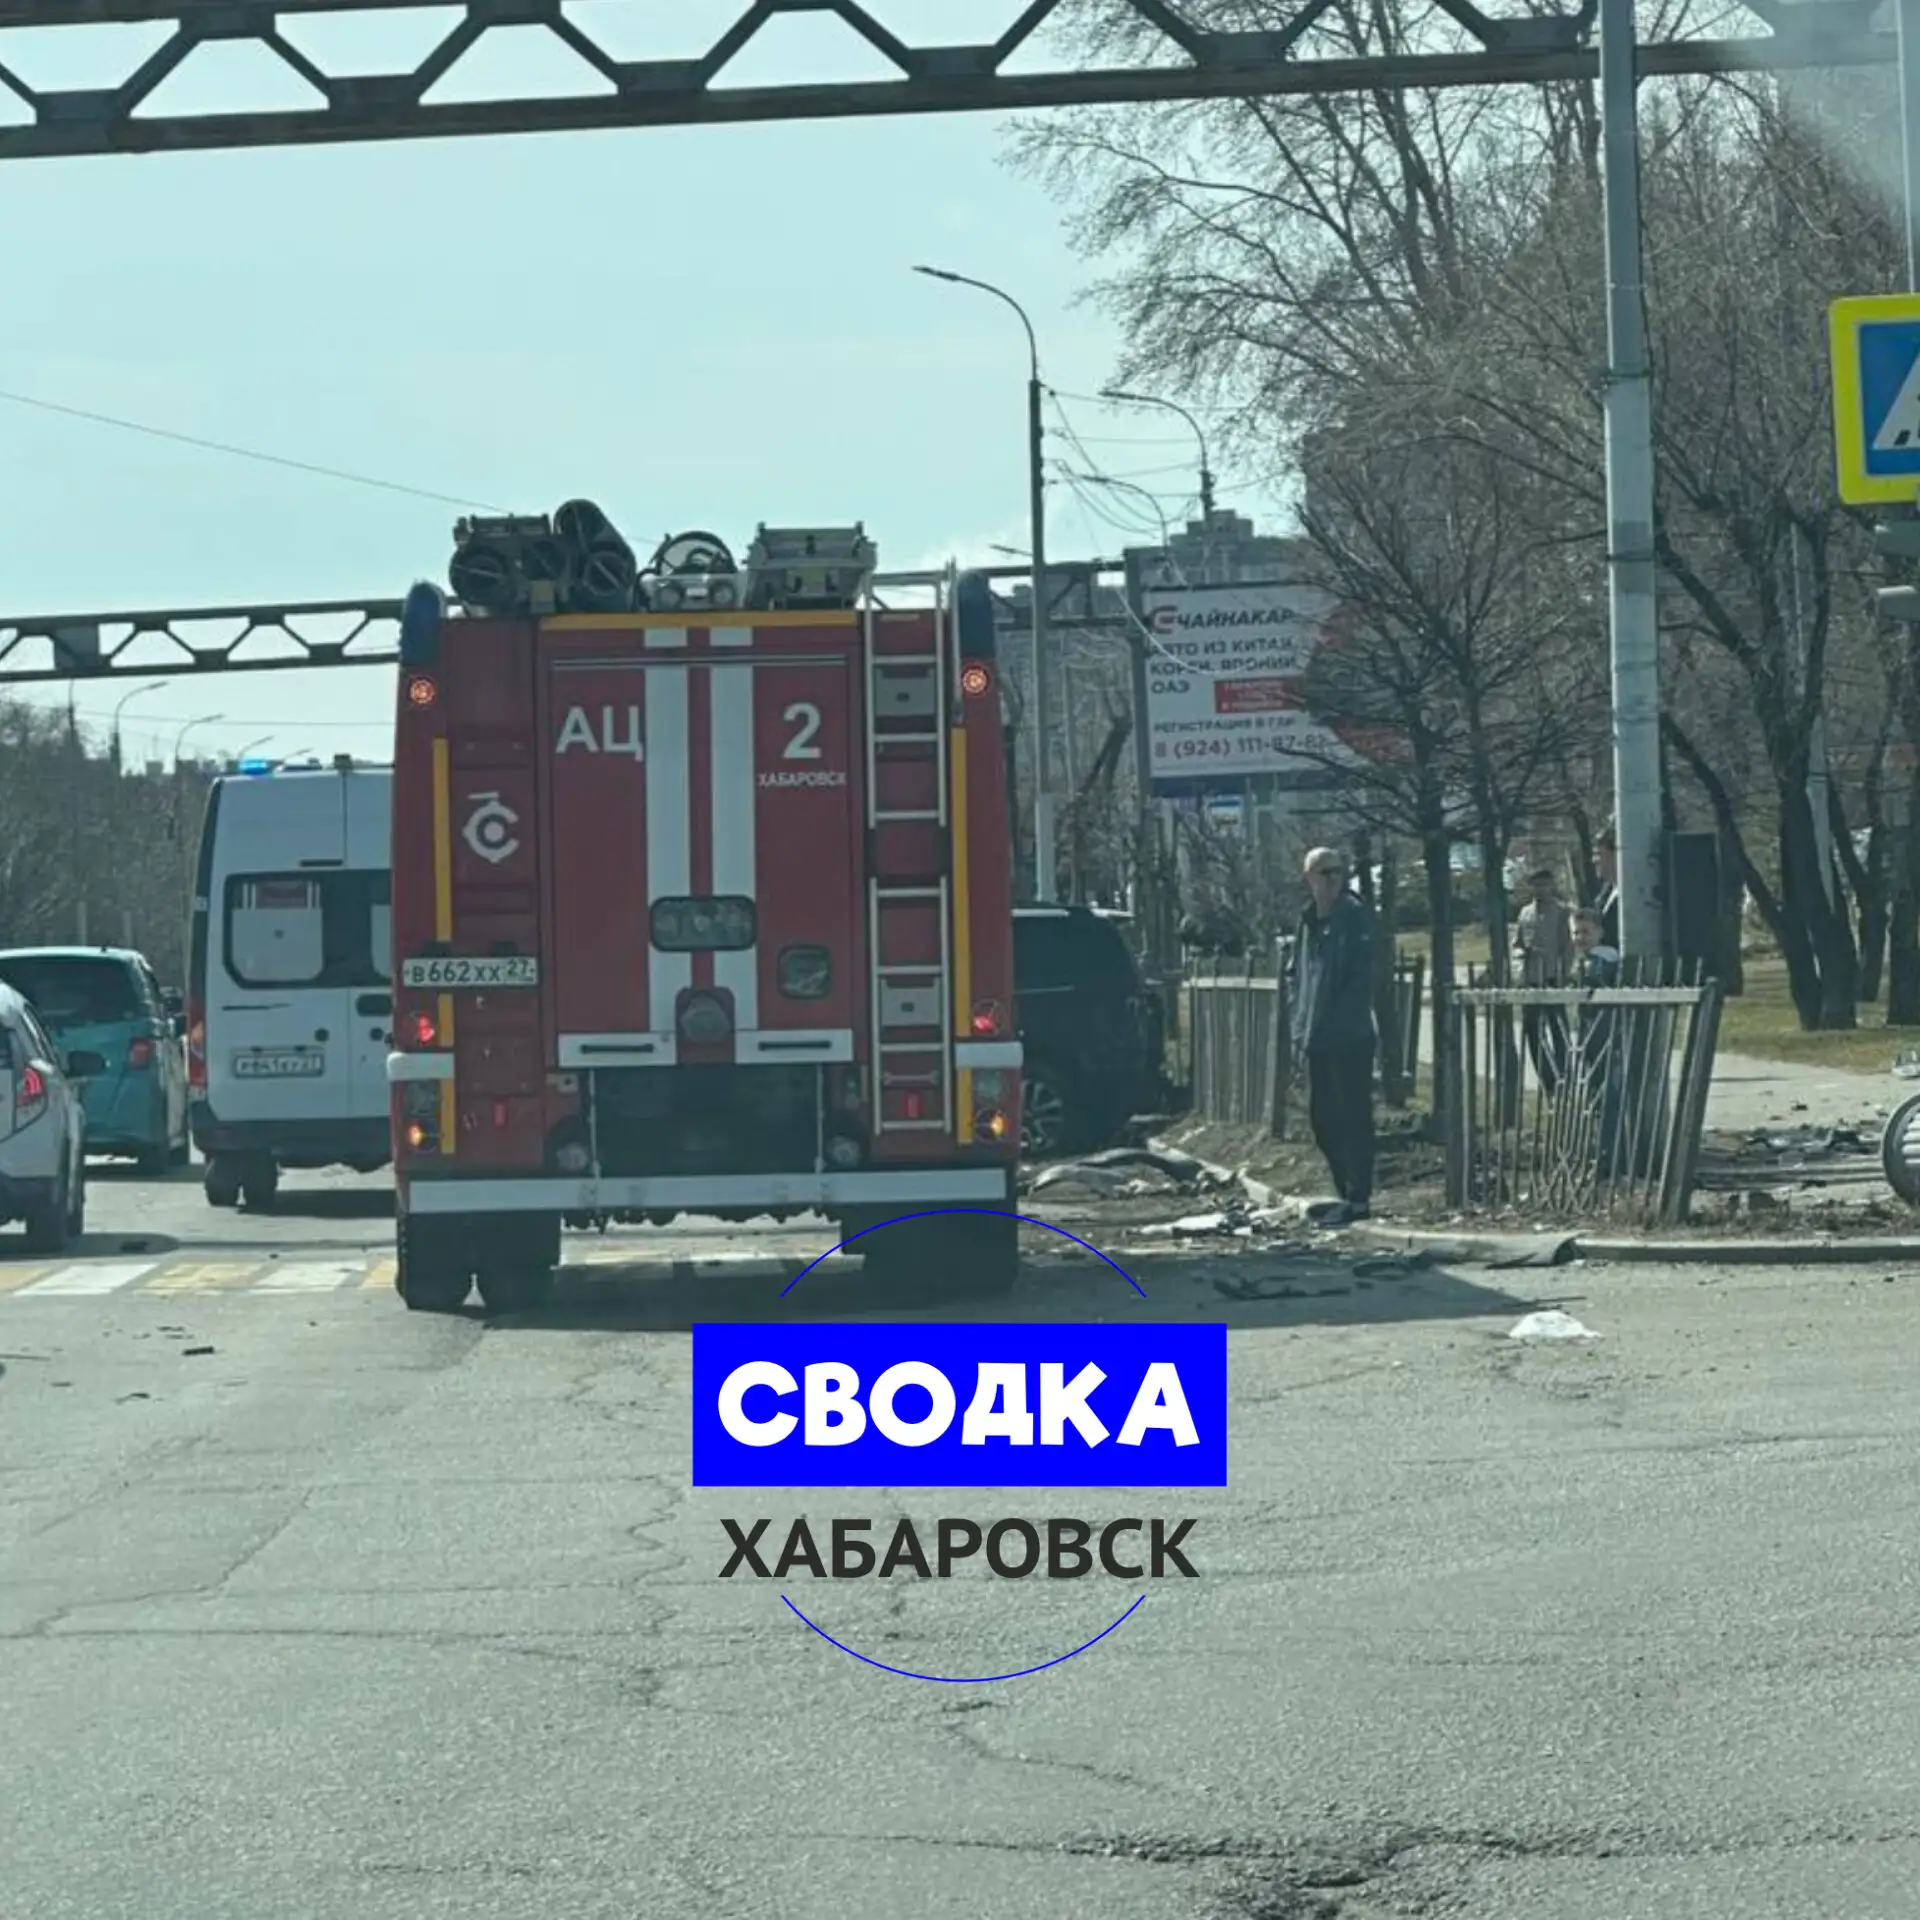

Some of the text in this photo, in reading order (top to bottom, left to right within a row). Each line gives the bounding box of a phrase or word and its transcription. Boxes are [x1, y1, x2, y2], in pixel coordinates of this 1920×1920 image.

[1178, 607, 1296, 629] ЧАЙНАКАР
[1204, 640, 1226, 655] ИЗ
[1151, 680, 1190, 694] ОАЭ
[555, 705, 643, 762] АЦ
[782, 703, 822, 759] 2
[1174, 738, 1231, 759] (924)
[757, 771, 847, 788] ХАБАРОВСК
